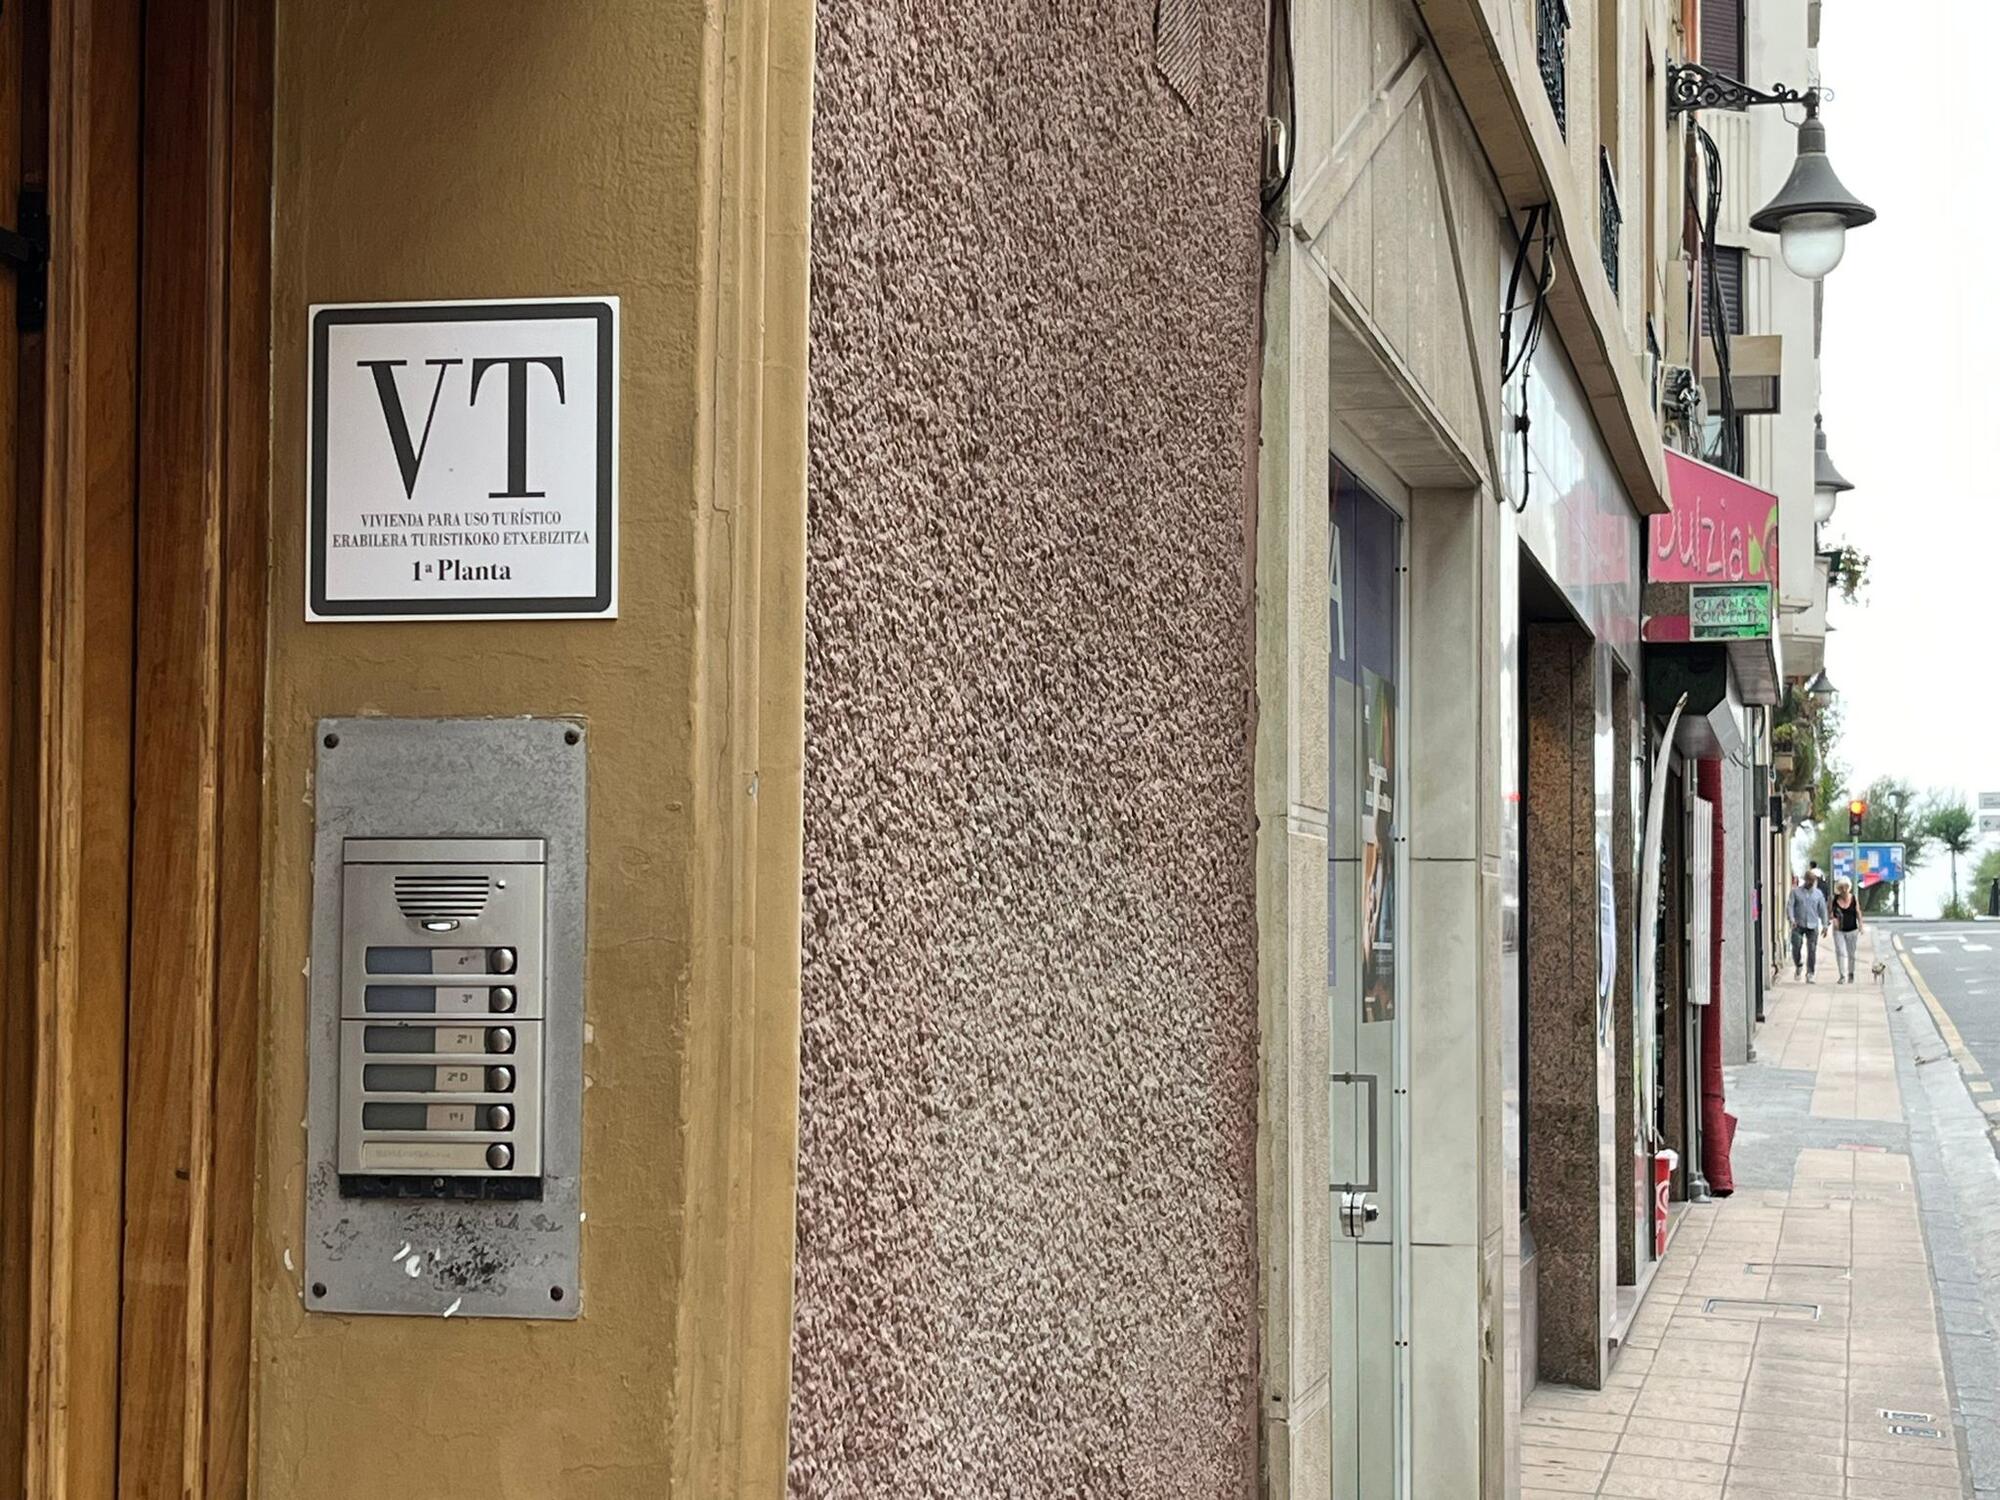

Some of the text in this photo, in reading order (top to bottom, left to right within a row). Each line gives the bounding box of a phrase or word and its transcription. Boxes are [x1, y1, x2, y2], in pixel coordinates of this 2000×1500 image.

[357, 356, 565, 499] VT
[360, 508, 562, 528] VIVIENDA PARA USO TURÍSTICO
[332, 530, 590, 548] ERABILERA TURISTIKOKO ETXEBIZITZA
[437, 559, 512, 581] Planta
[460, 1072, 469, 1082] D
